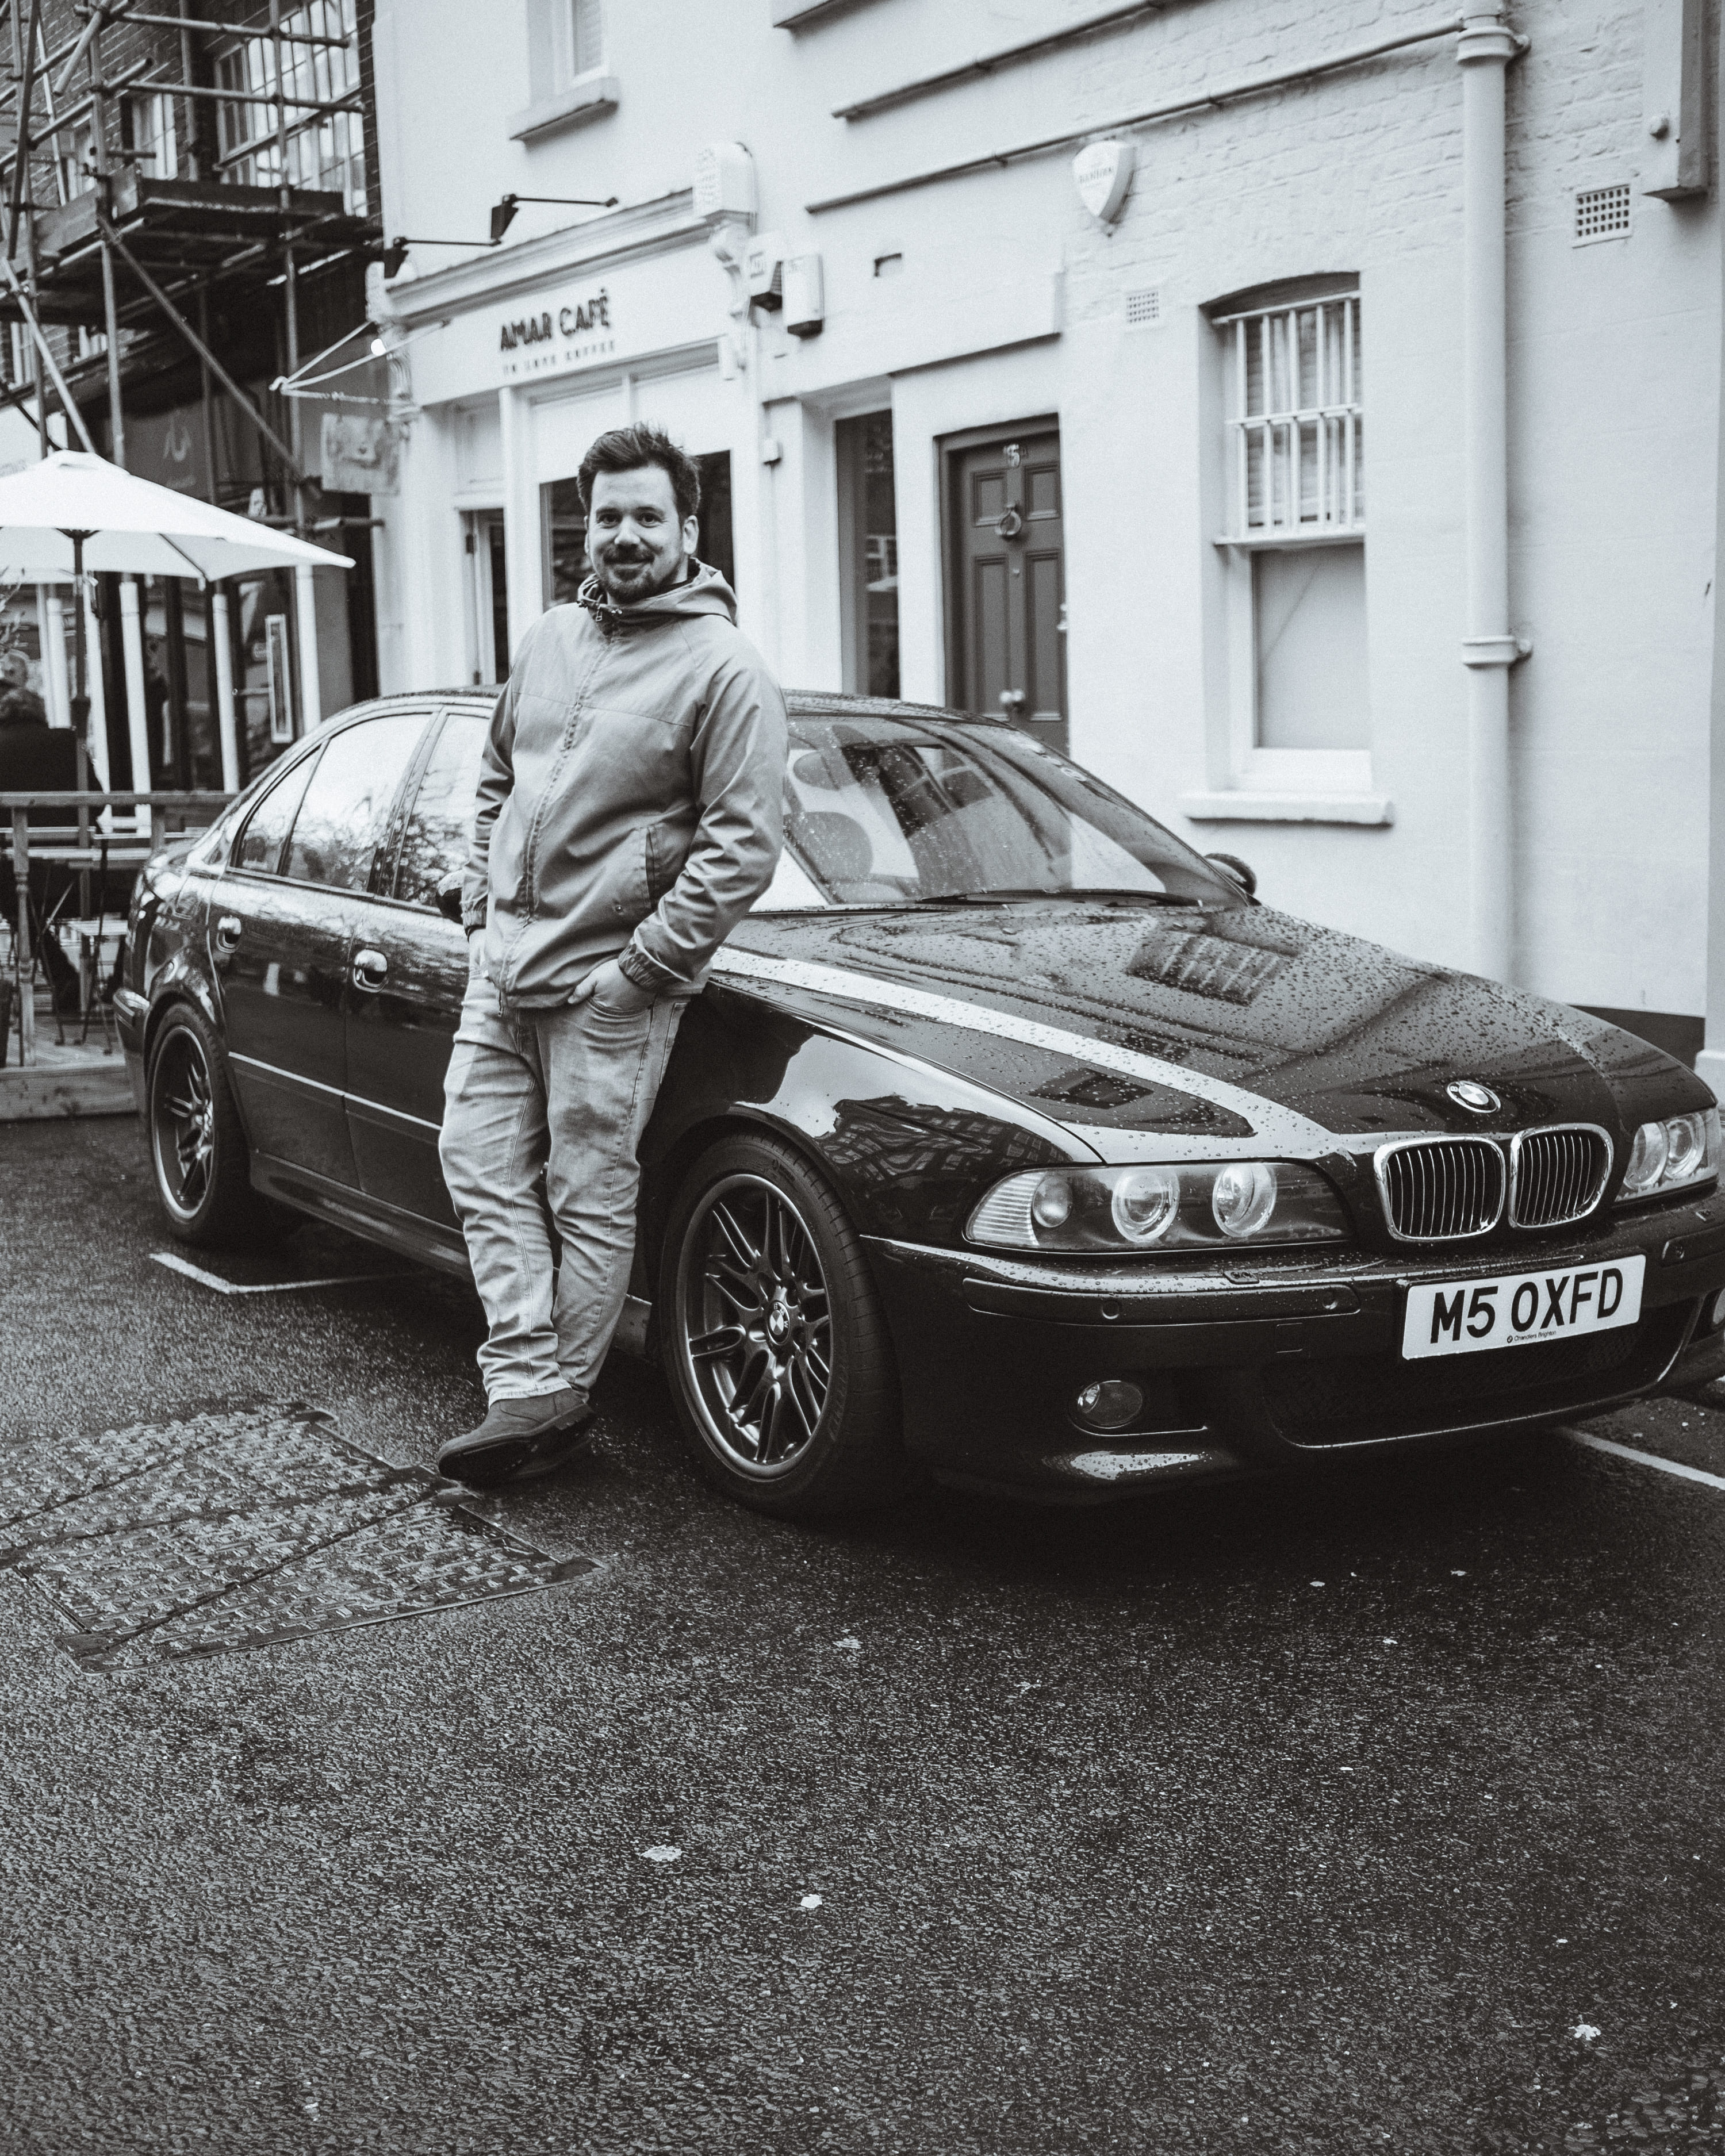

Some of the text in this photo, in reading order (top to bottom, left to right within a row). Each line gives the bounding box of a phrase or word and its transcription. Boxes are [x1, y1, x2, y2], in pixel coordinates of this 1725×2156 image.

[500, 312, 552, 351] AMAR
[1430, 1286, 1498, 1344] M5
[1514, 1333, 1537, 1341] Chandlers
